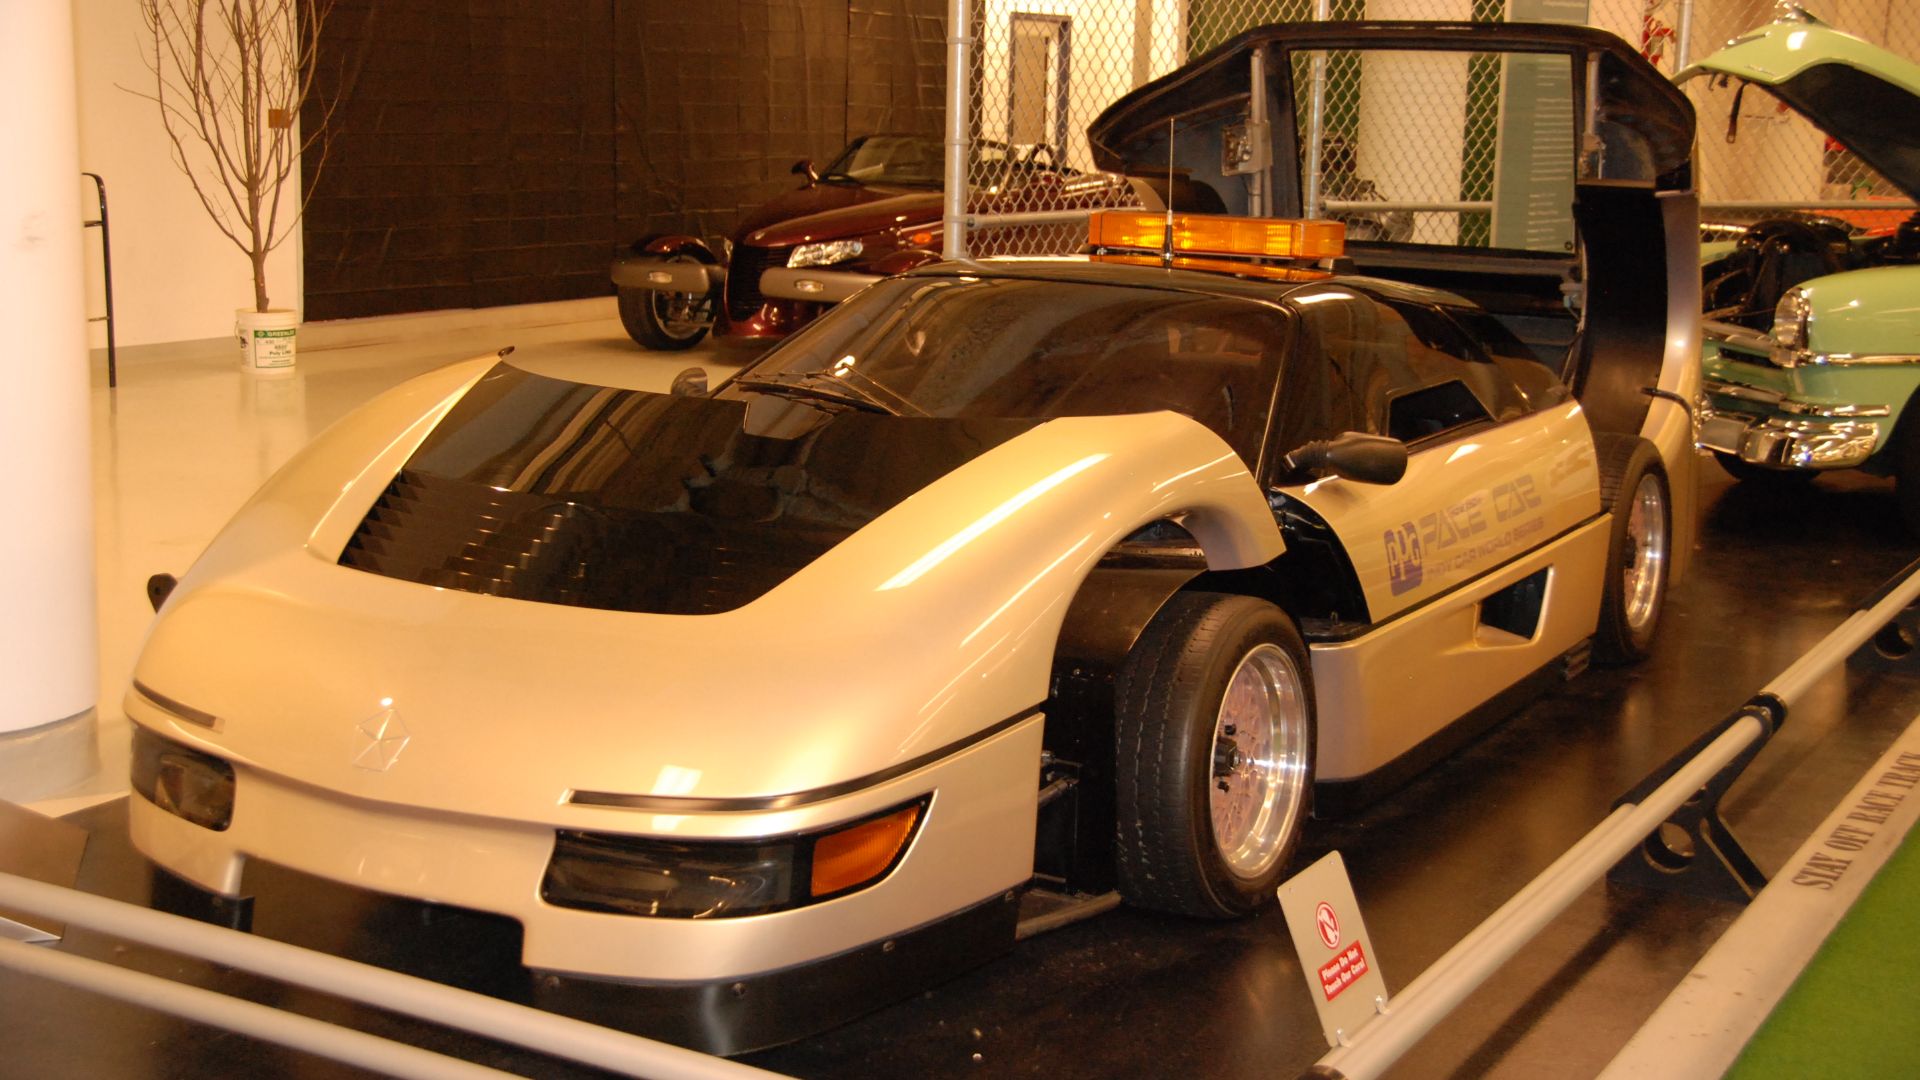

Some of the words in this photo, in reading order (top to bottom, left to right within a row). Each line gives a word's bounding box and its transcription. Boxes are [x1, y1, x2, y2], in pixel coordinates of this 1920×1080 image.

[1418, 497, 1488, 556] PACE
[1492, 474, 1542, 522] CAR
[1847, 789, 1905, 825] RACE
[1824, 824, 1875, 851] OFF
[1791, 852, 1852, 890] STAY
[1321, 962, 1340, 981] Please
[1339, 956, 1348, 967] Do
[1347, 947, 1359, 961] Not
[1325, 977, 1342, 995] Touch
[1340, 970, 1352, 983] Our
